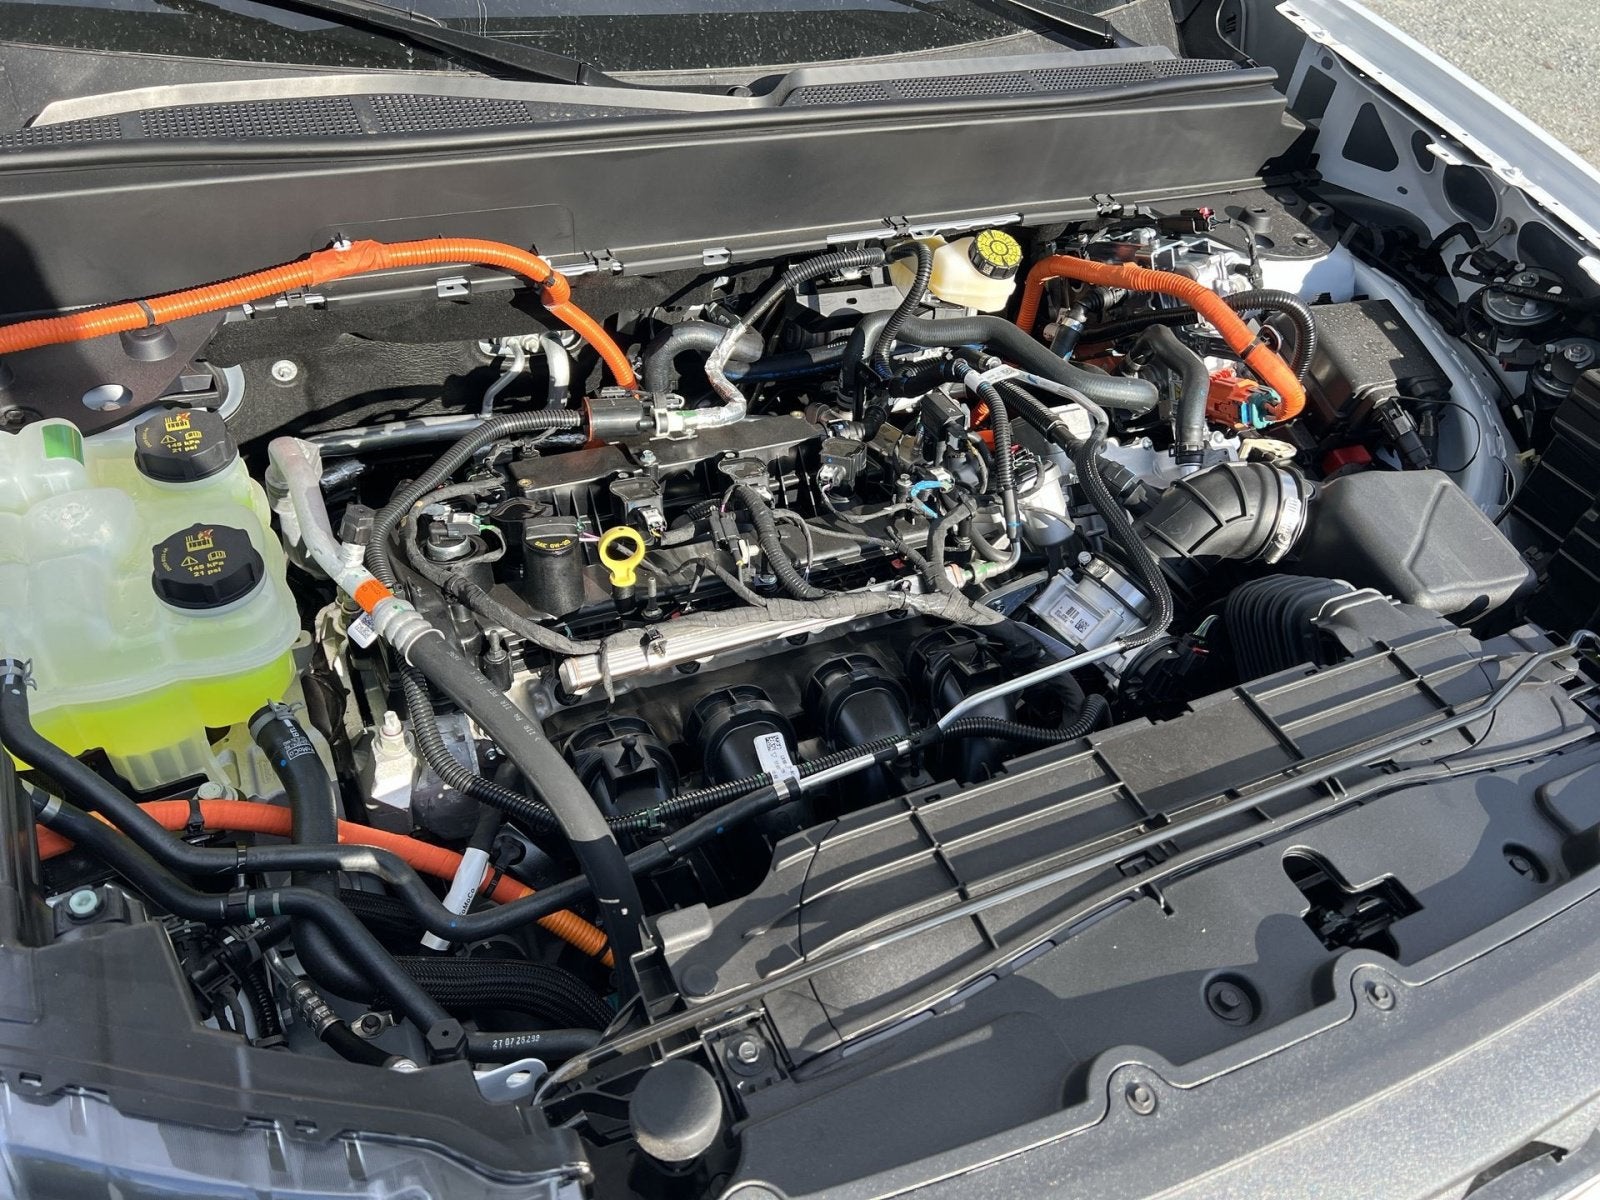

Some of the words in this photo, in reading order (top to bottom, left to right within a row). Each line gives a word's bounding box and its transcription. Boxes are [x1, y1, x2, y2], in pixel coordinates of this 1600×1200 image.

[187, 564, 205, 572] 145
[206, 560, 224, 568] kPa
[207, 567, 222, 575] psi
[459, 888, 475, 916] oMoCo
